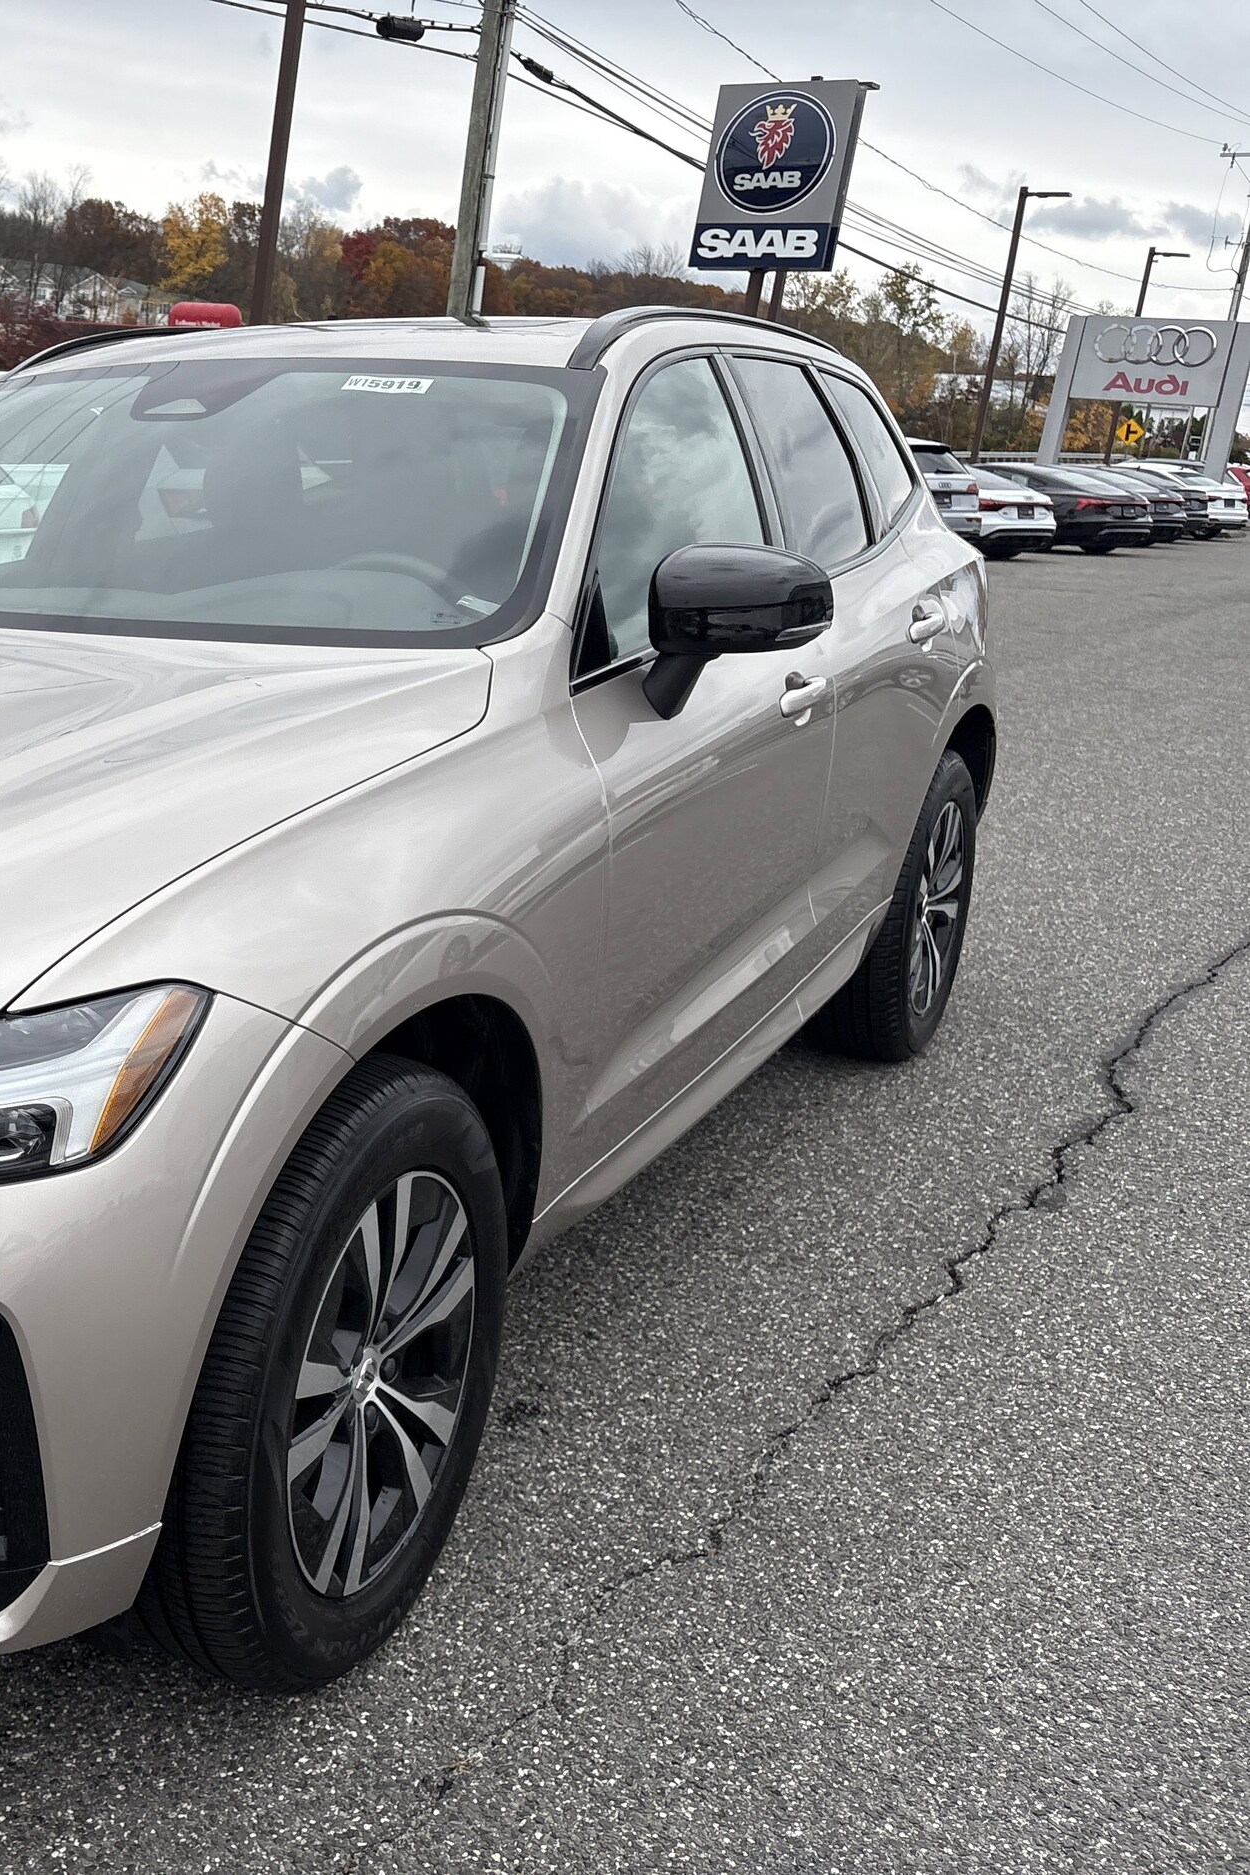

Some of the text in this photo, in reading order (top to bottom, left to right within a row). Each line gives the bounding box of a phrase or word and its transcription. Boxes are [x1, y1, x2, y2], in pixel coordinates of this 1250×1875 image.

[733, 171, 801, 191] SAAB
[697, 228, 818, 259] SAAB
[1102, 371, 1189, 396] Audi
